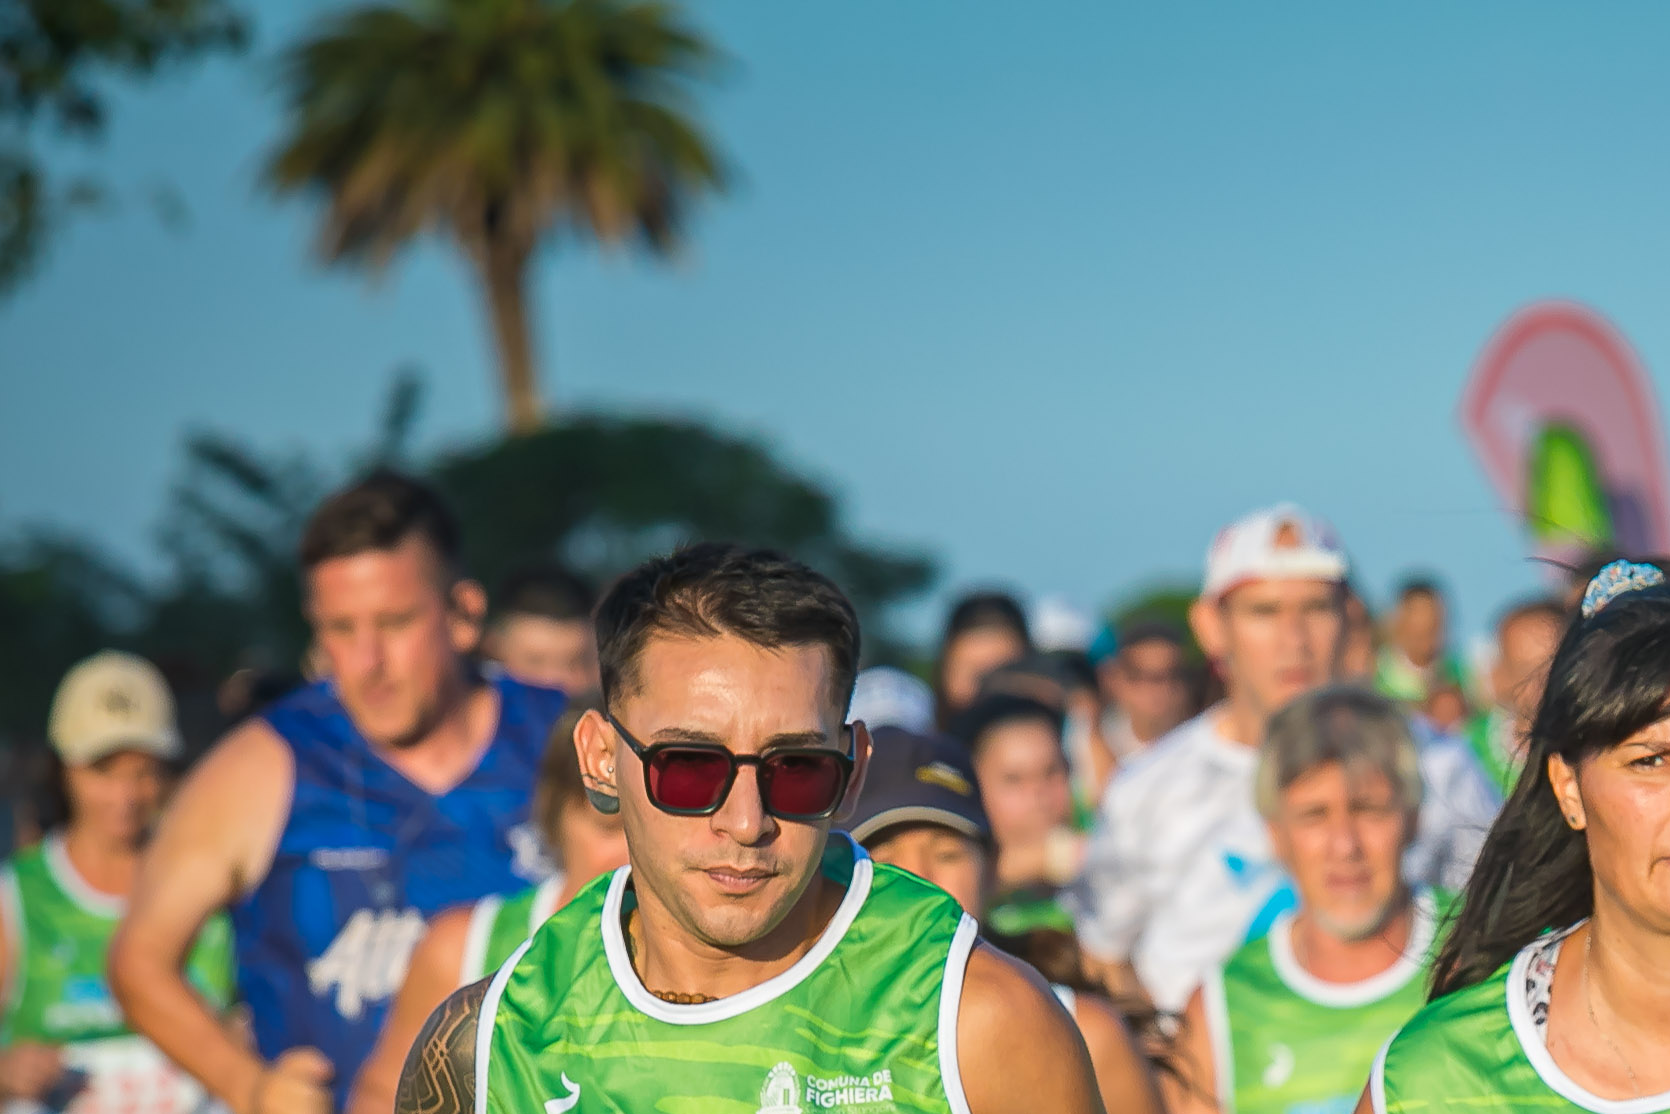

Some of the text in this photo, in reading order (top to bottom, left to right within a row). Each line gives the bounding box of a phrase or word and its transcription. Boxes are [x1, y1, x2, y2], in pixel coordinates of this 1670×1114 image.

[807, 1069, 892, 1091] COMUNA DE
[806, 1085, 894, 1108] FIGHIERA
